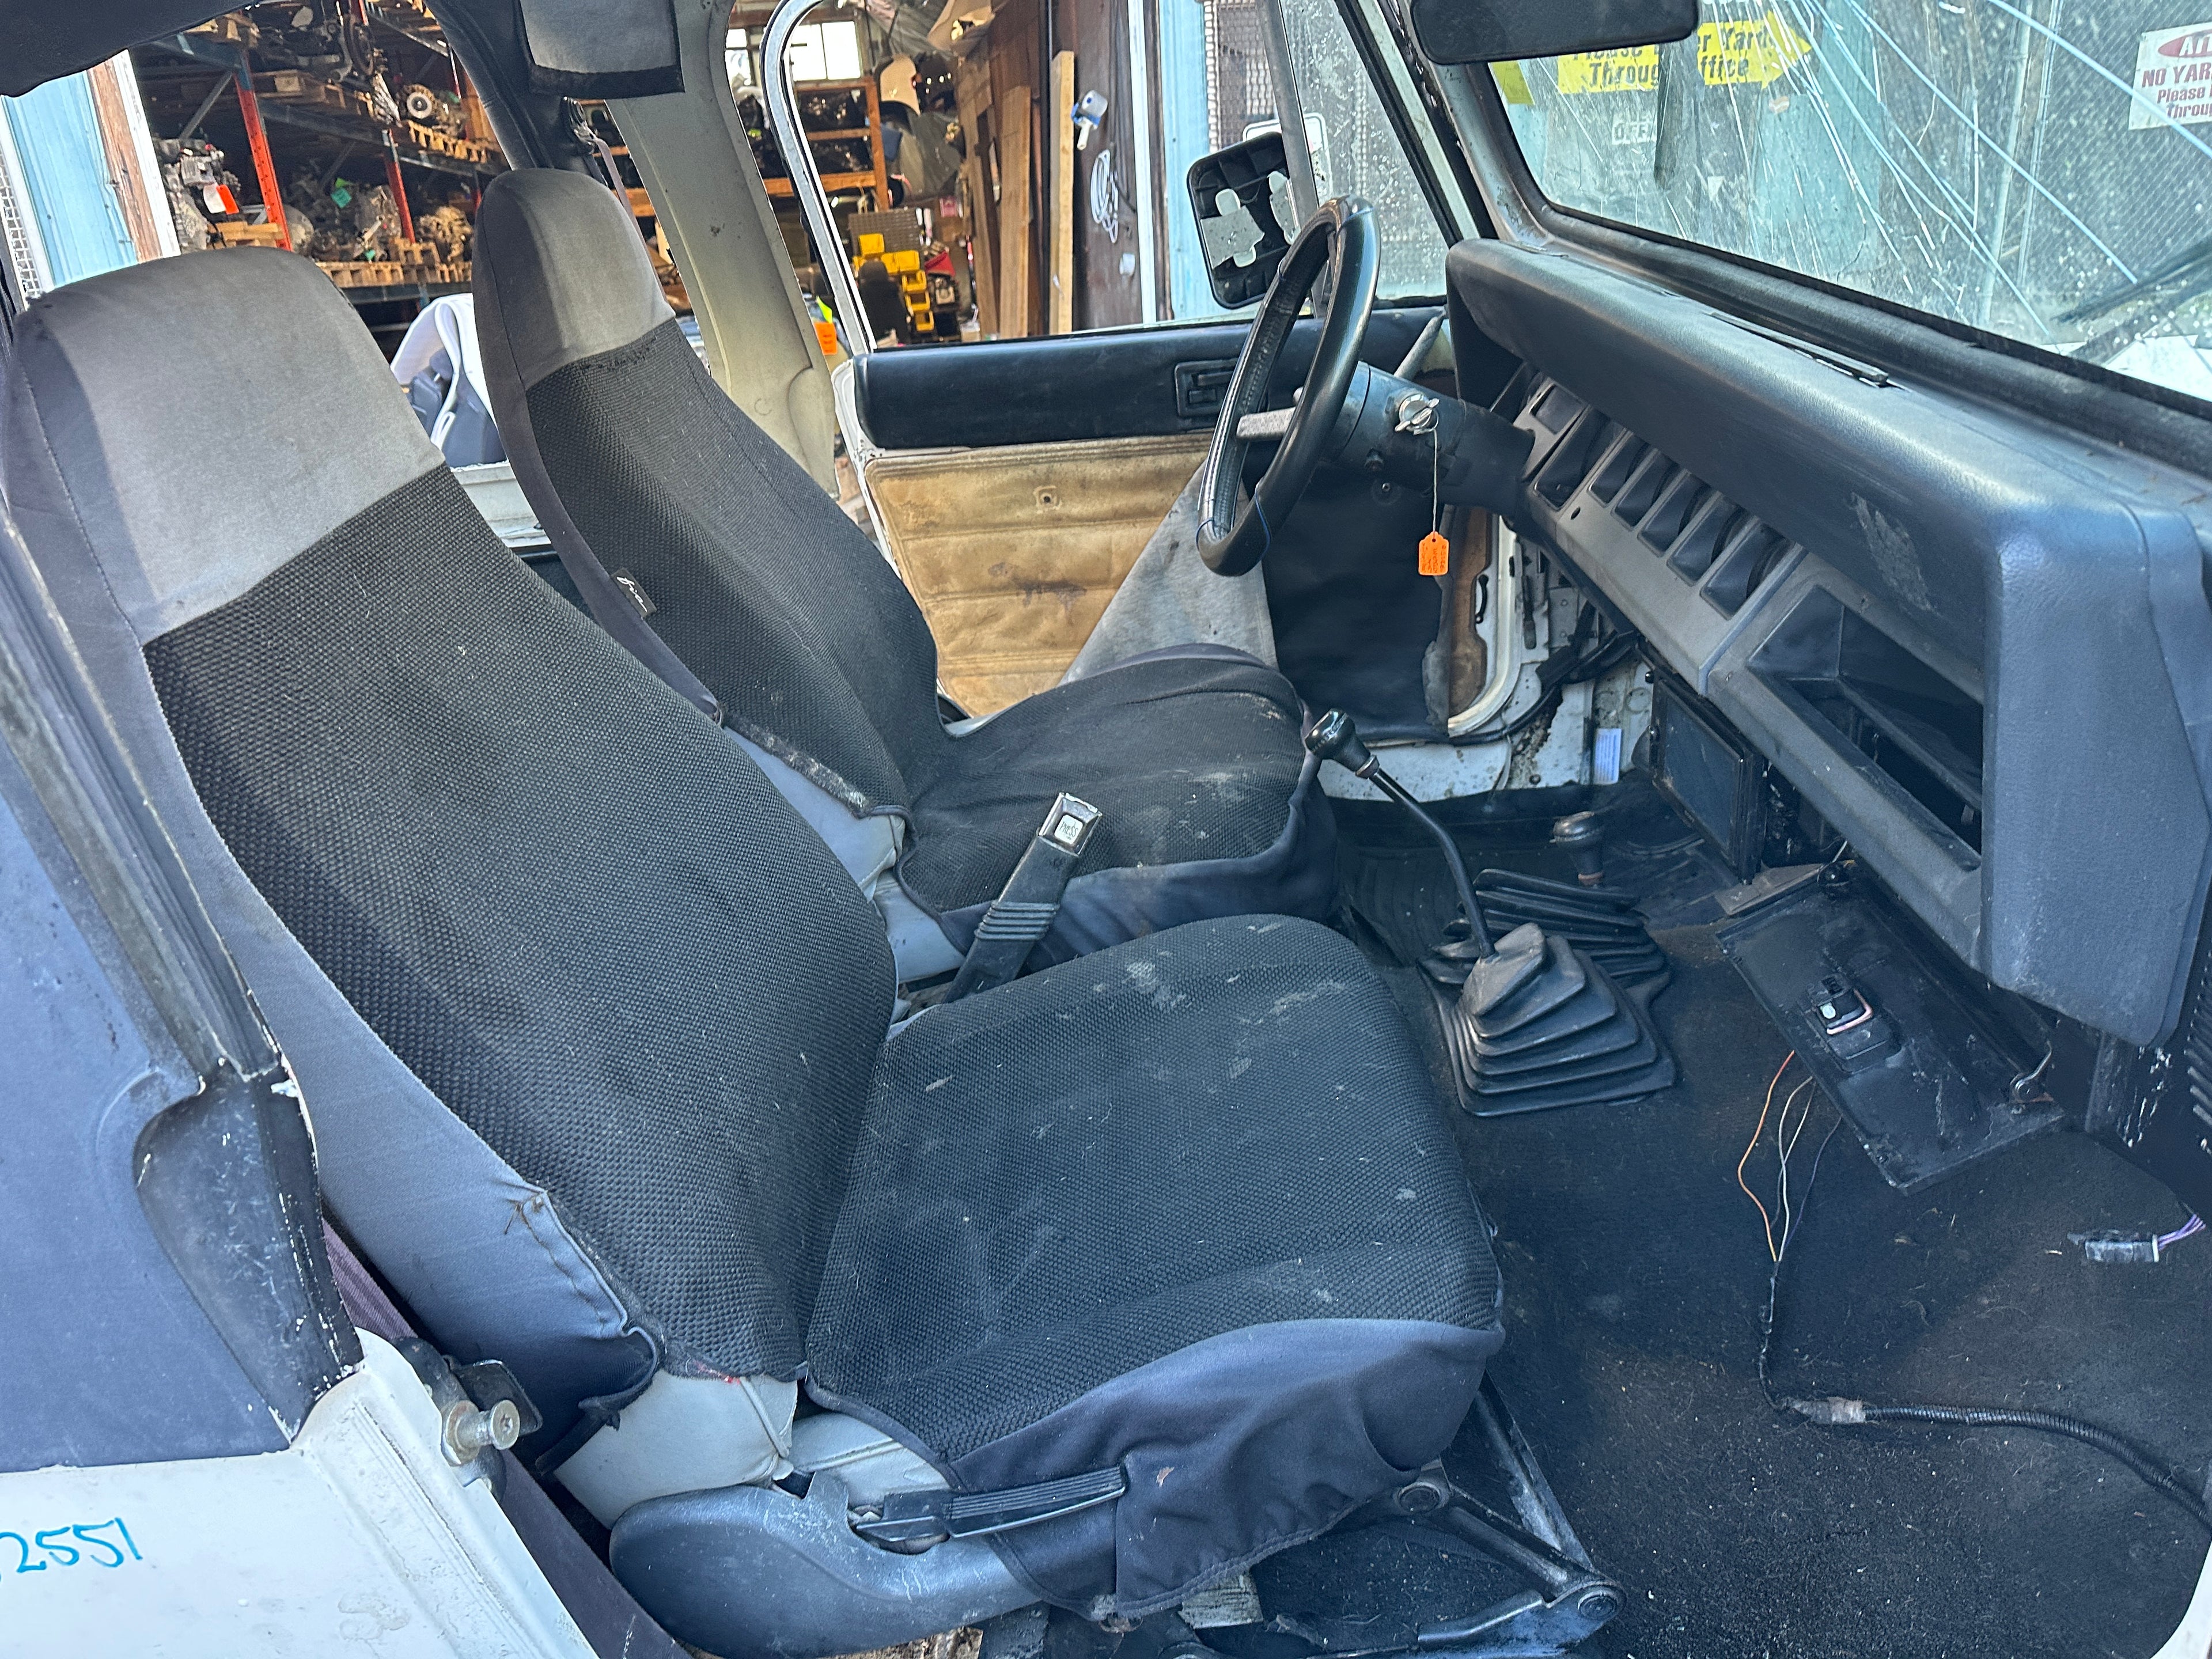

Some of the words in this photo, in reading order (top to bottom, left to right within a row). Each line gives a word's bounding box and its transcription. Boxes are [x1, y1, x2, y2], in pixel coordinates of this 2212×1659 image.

[2142, 68, 2167, 88] NO
[2173, 62, 2212, 84] YAR
[2157, 86, 2206, 104] Please
[1059, 821, 1079, 838] PRESS
[0, 1517, 143, 1573] 2551
